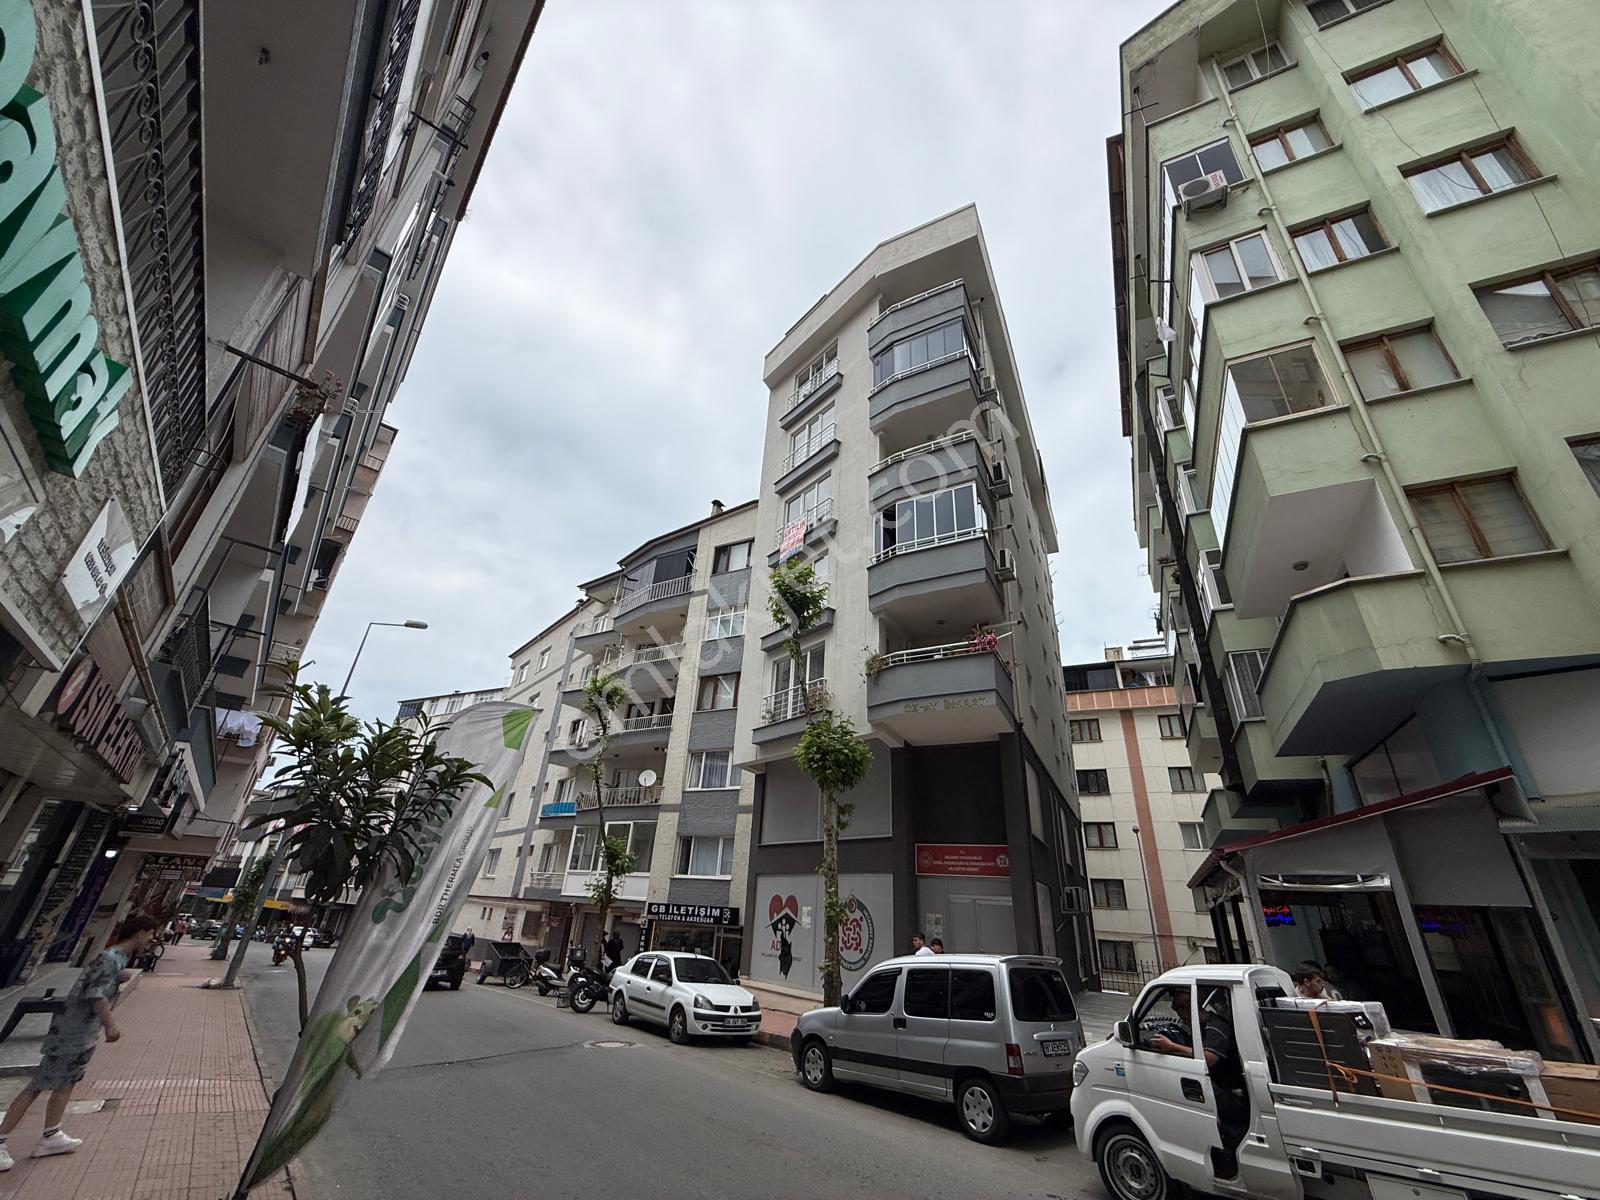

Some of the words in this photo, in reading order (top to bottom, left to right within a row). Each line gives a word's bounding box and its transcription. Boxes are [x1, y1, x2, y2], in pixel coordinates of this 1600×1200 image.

[432, 902, 446, 925] BDR
[441, 856, 464, 902] THERMEA
[458, 825, 474, 858] GROUP
[651, 904, 666, 913] GB
[668, 903, 721, 917] İLETİŞİM
[686, 915, 714, 924] AKSESUAR
